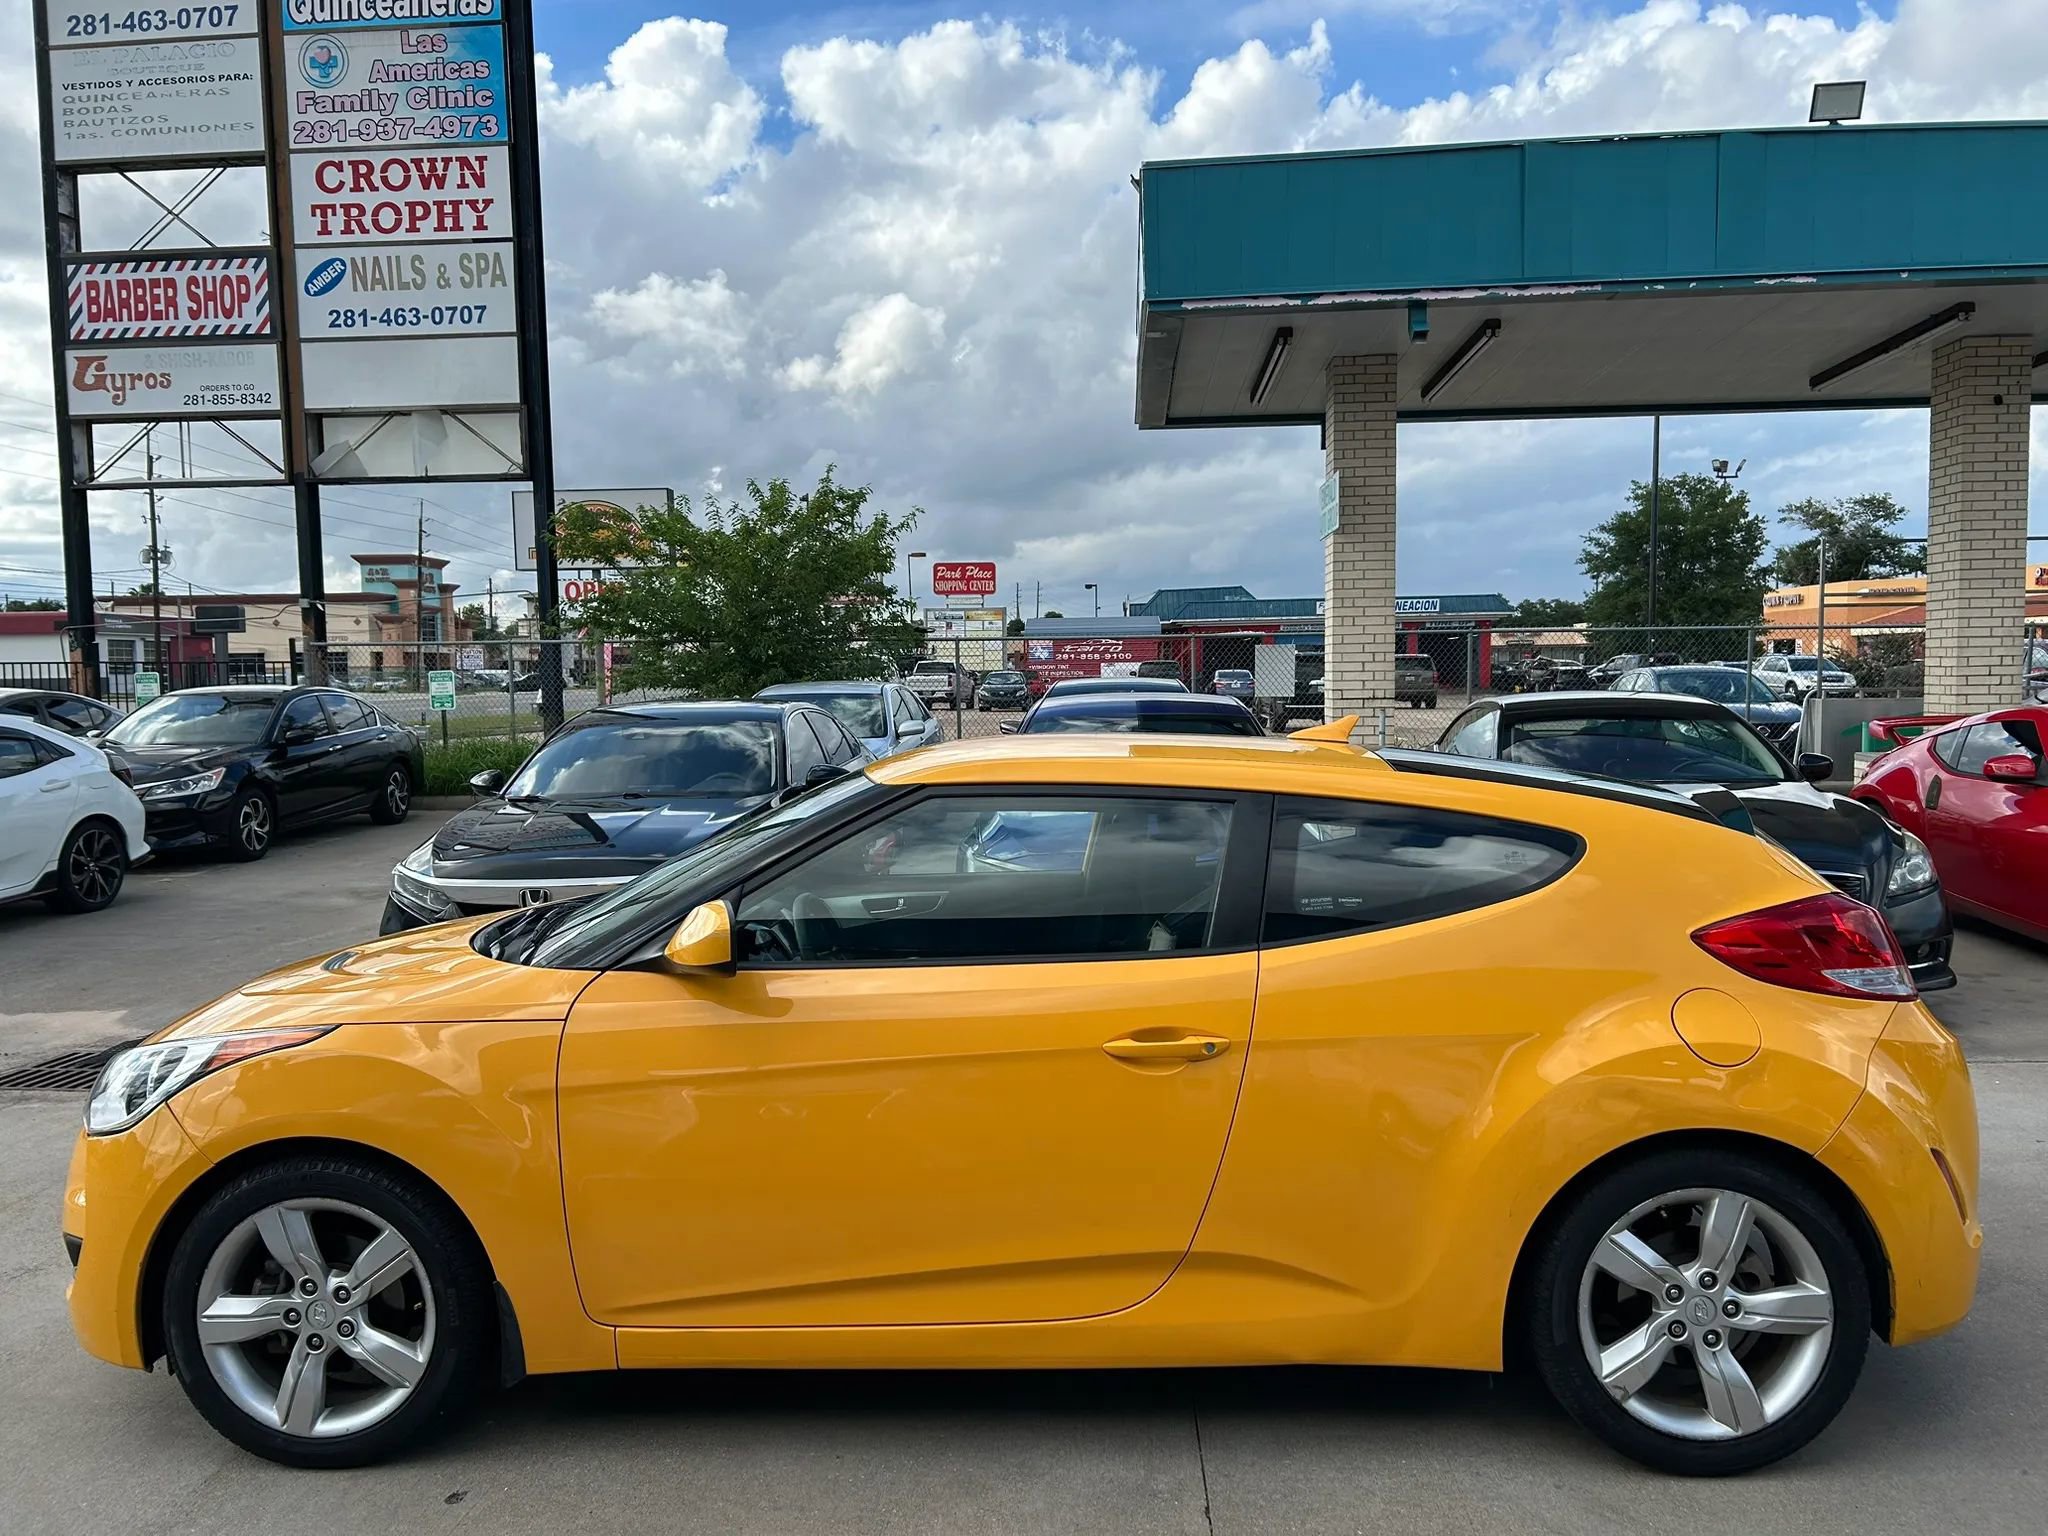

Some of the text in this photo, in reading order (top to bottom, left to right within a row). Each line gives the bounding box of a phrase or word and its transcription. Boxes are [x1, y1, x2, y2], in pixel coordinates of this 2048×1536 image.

[66, 4, 240, 38] 281-463-0707
[400, 29, 448, 55] Las
[62, 72, 254, 92] VESTIDOS Y ACCESORIOS PARA:
[368, 56, 490, 84] Americas
[62, 104, 134, 117] BODAS
[296, 85, 495, 117] Family Clinic
[63, 114, 170, 129] BAUTIZOS
[110, 121, 255, 138] COMUNIONES
[293, 114, 500, 144] 281-937-4973
[314, 155, 489, 195] CROWN
[310, 198, 495, 237] TROPHY
[307, 252, 508, 296] AMBER NAILS & SPA
[85, 274, 251, 324] BARBER SHOP
[327, 305, 488, 329] 281-463-0707
[72, 355, 172, 407] Gyros
[199, 384, 230, 392] ORDERS
[243, 383, 255, 391] GO
[183, 392, 272, 406] 281-855-8342
[935, 580, 994, 591] SHOPPING CENTER
[937, 566, 993, 579] Park Place
